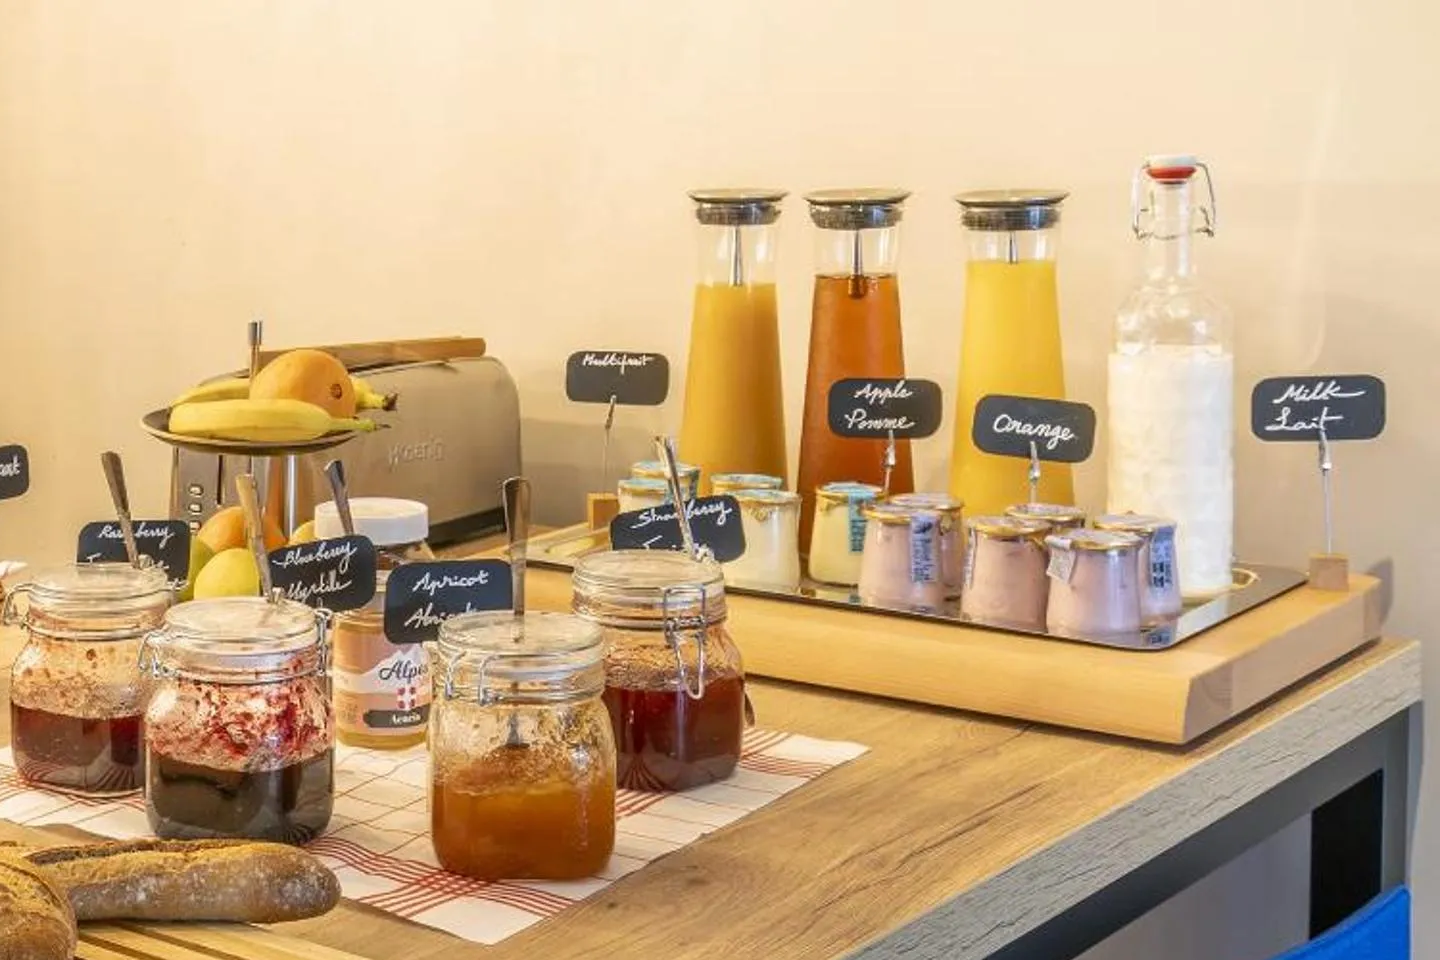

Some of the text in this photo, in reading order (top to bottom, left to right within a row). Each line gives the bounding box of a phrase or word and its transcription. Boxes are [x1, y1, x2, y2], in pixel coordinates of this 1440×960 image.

[854, 380, 913, 404] Apple
[1272, 380, 1366, 404] Milk
[844, 408, 916, 429] Pomme
[1264, 406, 1344, 431] Lait
[992, 414, 1075, 450] Orange
[272, 541, 358, 574] Blueberry
[412, 569, 489, 595] Apricot
